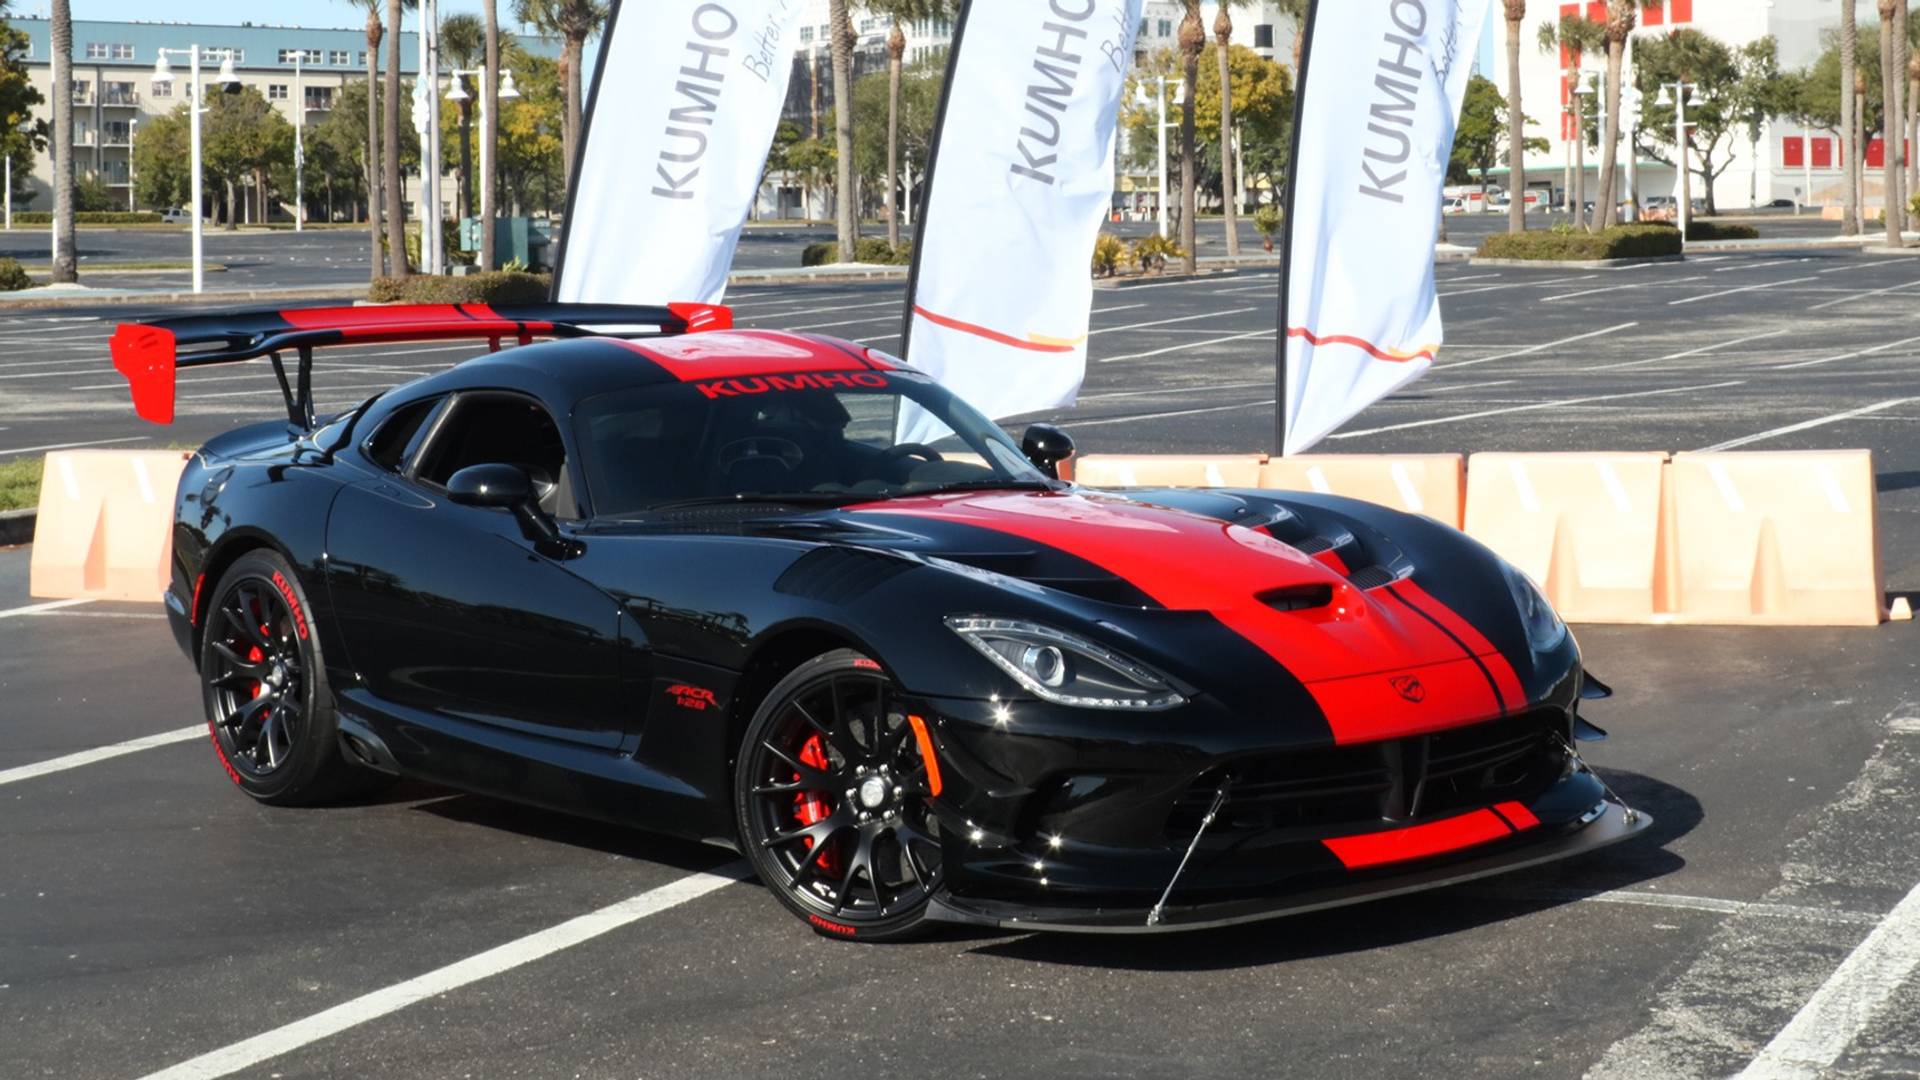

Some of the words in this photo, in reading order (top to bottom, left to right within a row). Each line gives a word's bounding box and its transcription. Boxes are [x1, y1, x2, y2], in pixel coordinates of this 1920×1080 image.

[651, 2, 738, 200] KUMHO
[1358, 0, 1427, 203] KUMHO
[696, 372, 890, 400] KUMHO
[271, 570, 309, 640] KUMHO
[674, 684, 717, 705] ACR
[807, 913, 857, 937] KUMHO
